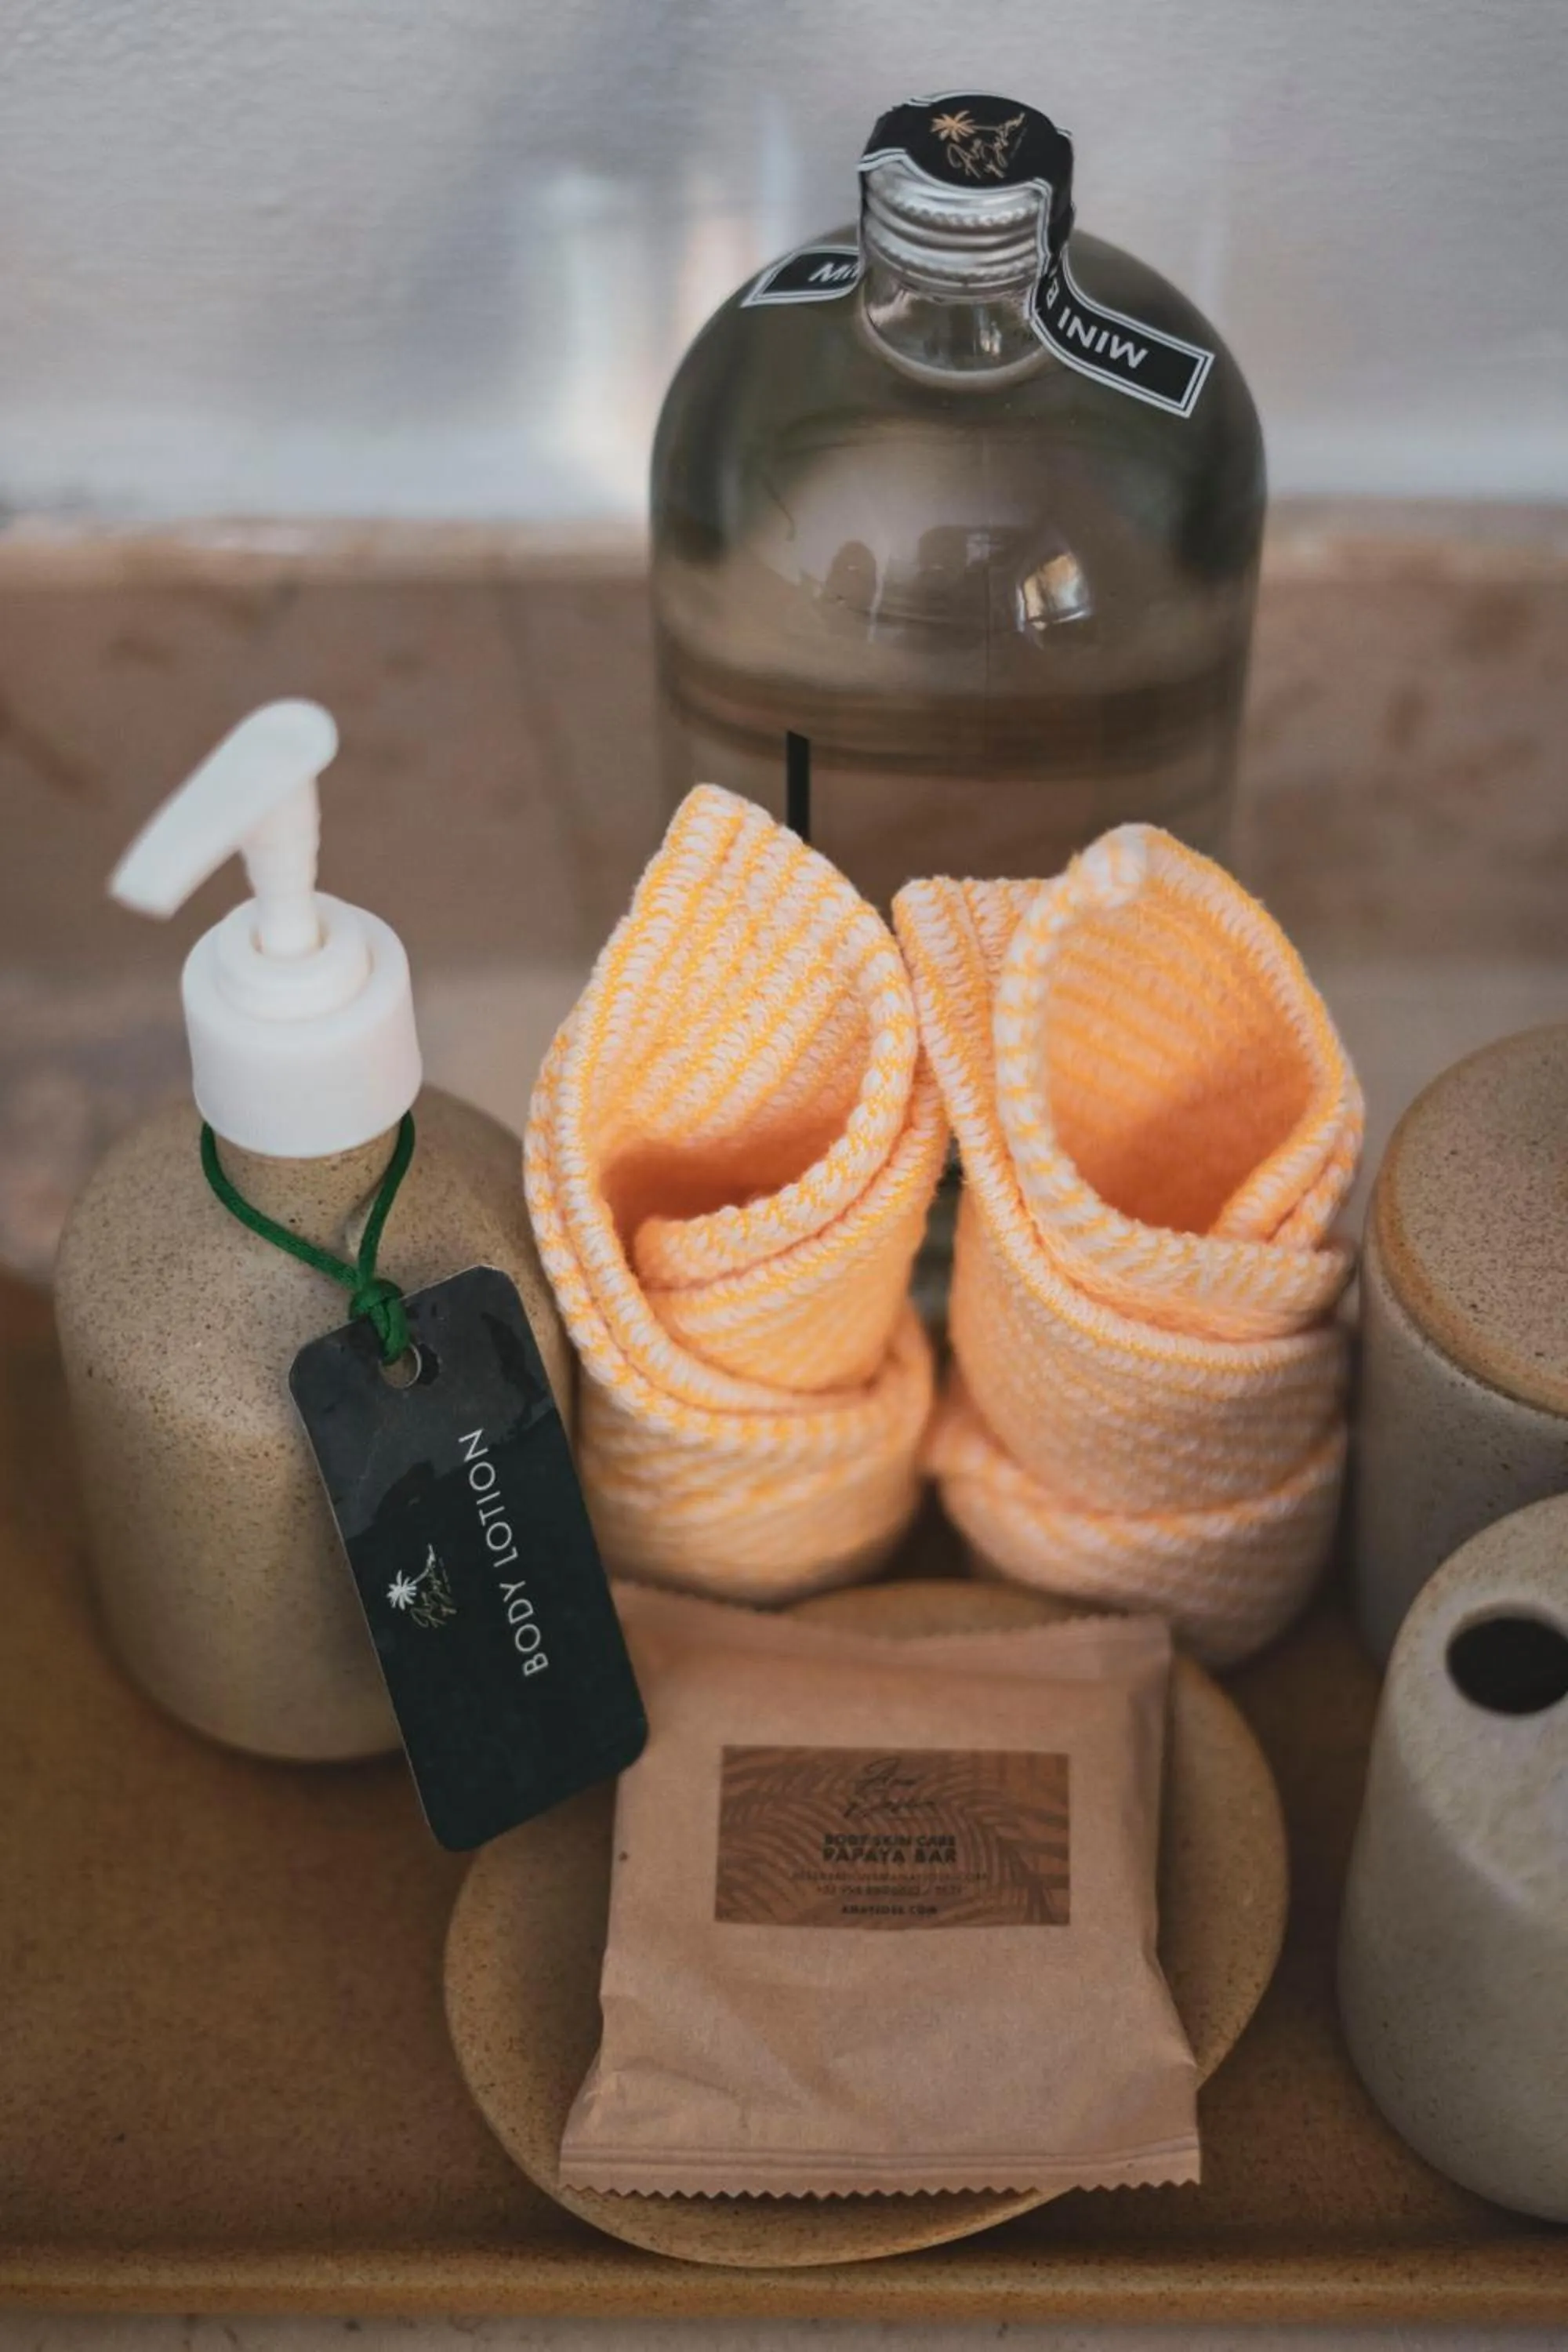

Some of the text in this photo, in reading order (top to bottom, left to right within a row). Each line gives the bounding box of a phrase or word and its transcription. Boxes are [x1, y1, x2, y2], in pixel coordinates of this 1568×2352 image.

[1057, 306, 1149, 369] MINI
[458, 1427, 550, 1678] BODY LOTION
[823, 1846, 956, 1864] PAPAYA BAR
[825, 1834, 955, 1846] BODY SKIN CARE
